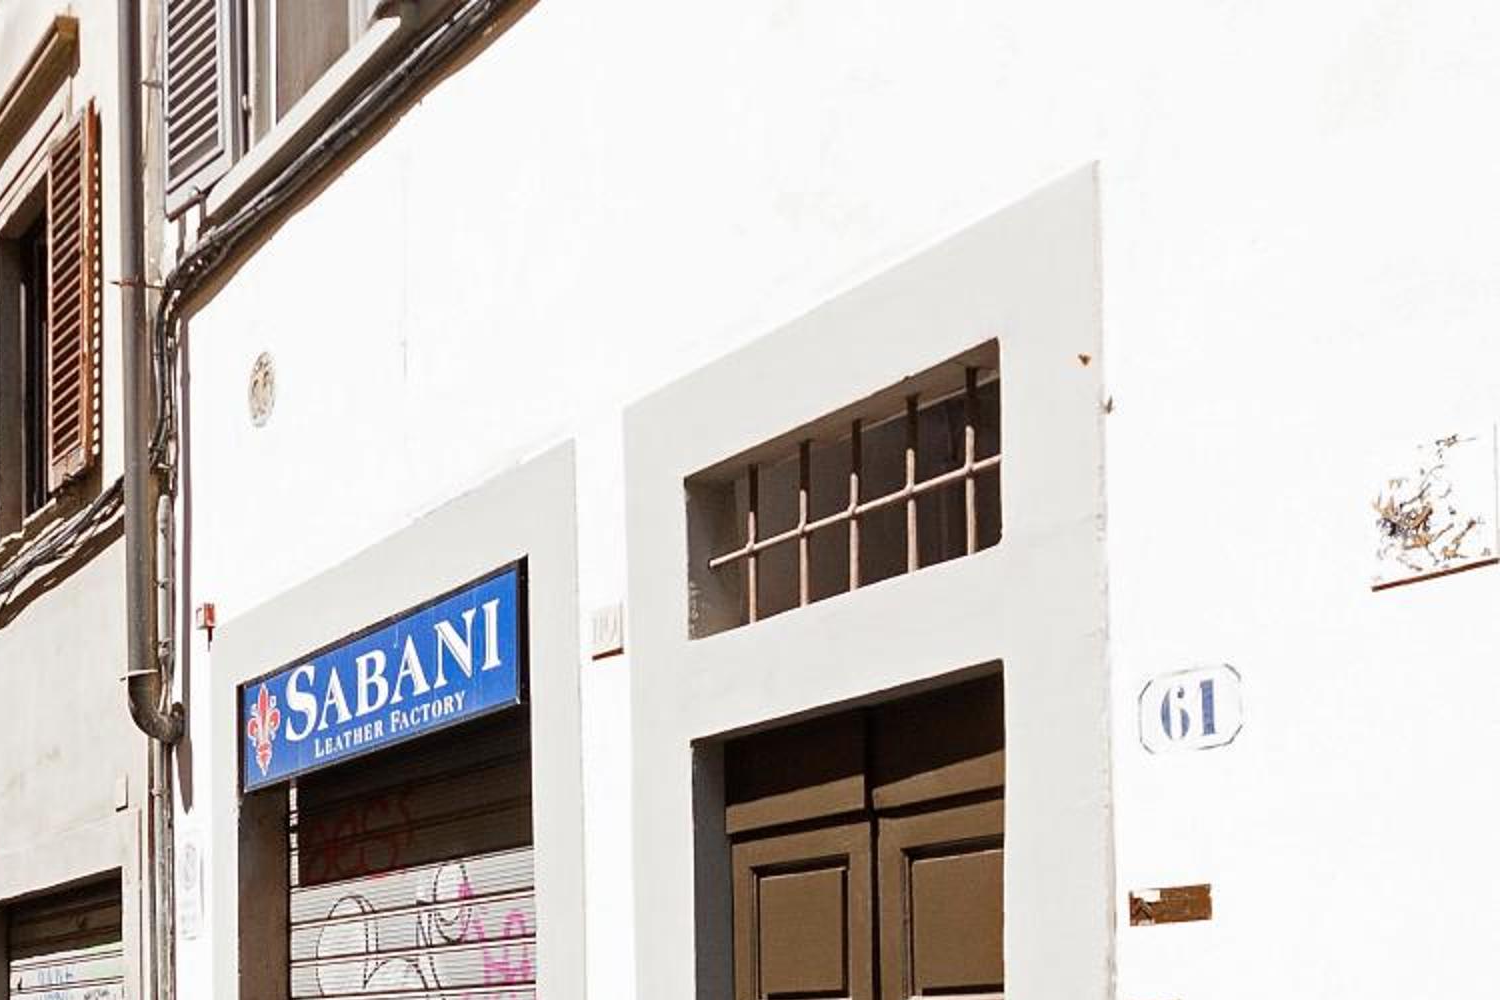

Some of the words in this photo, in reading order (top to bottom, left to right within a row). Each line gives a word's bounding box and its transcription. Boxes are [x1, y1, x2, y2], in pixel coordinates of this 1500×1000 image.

[286, 599, 501, 741] SABANI
[316, 721, 383, 757] LEATHER
[390, 691, 466, 732] FACTORY
[1161, 679, 1216, 741] 61
